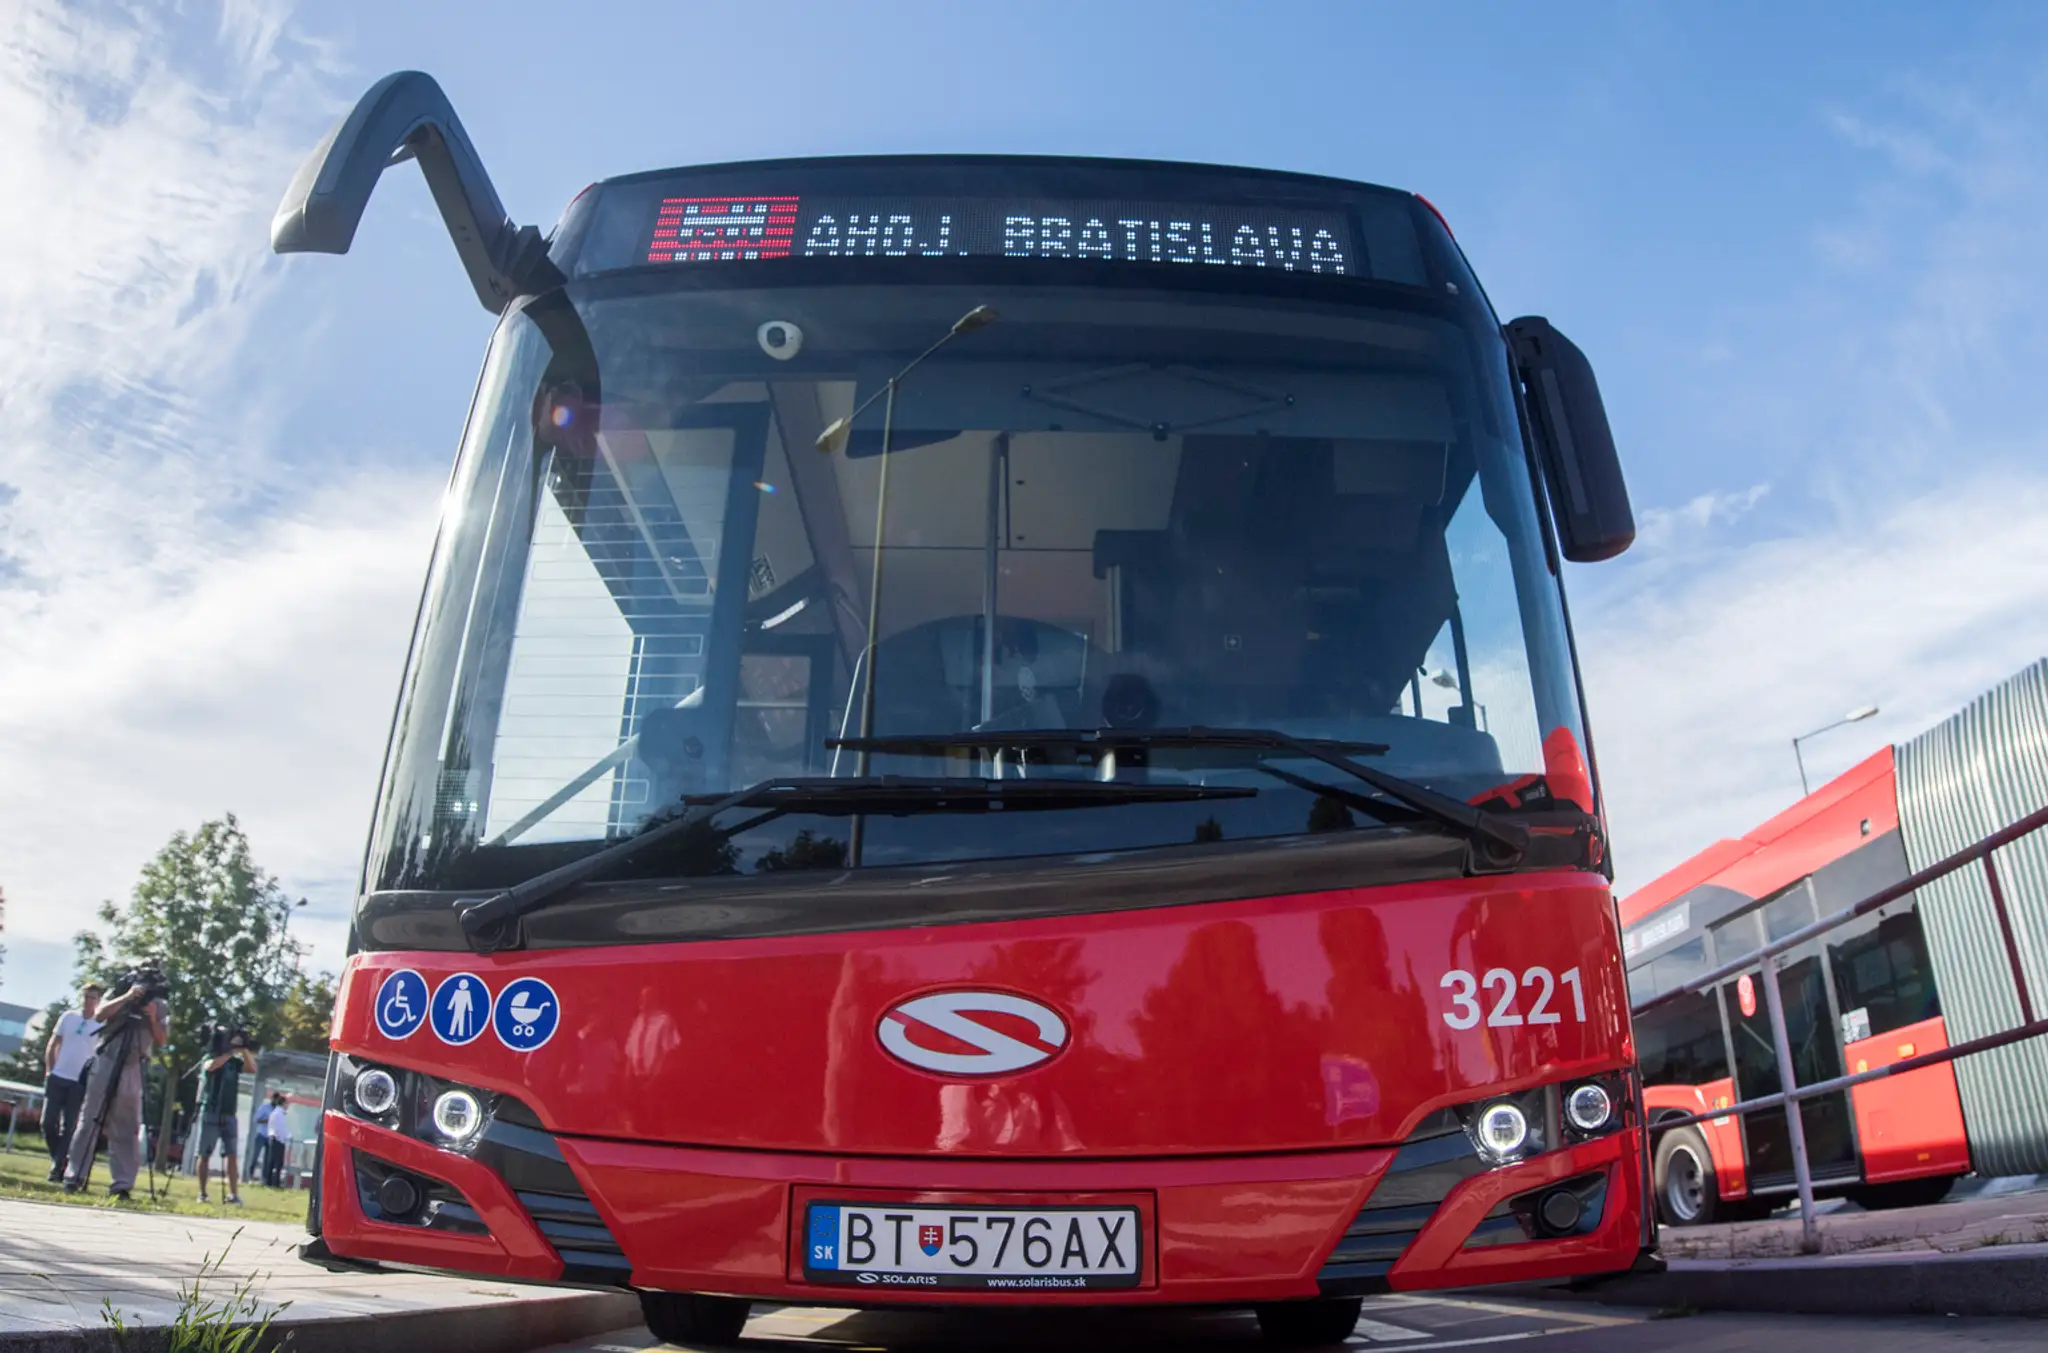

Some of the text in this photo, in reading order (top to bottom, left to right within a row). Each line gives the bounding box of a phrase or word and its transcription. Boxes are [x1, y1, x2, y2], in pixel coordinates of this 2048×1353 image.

[1004, 216, 1345, 274] BRATISLAVA
[1440, 966, 1586, 1030] 3221
[813, 1245, 834, 1260] SK
[882, 1274, 938, 1285] SOLARIS
[987, 1276, 1087, 1288] www.solarisbus.sk
